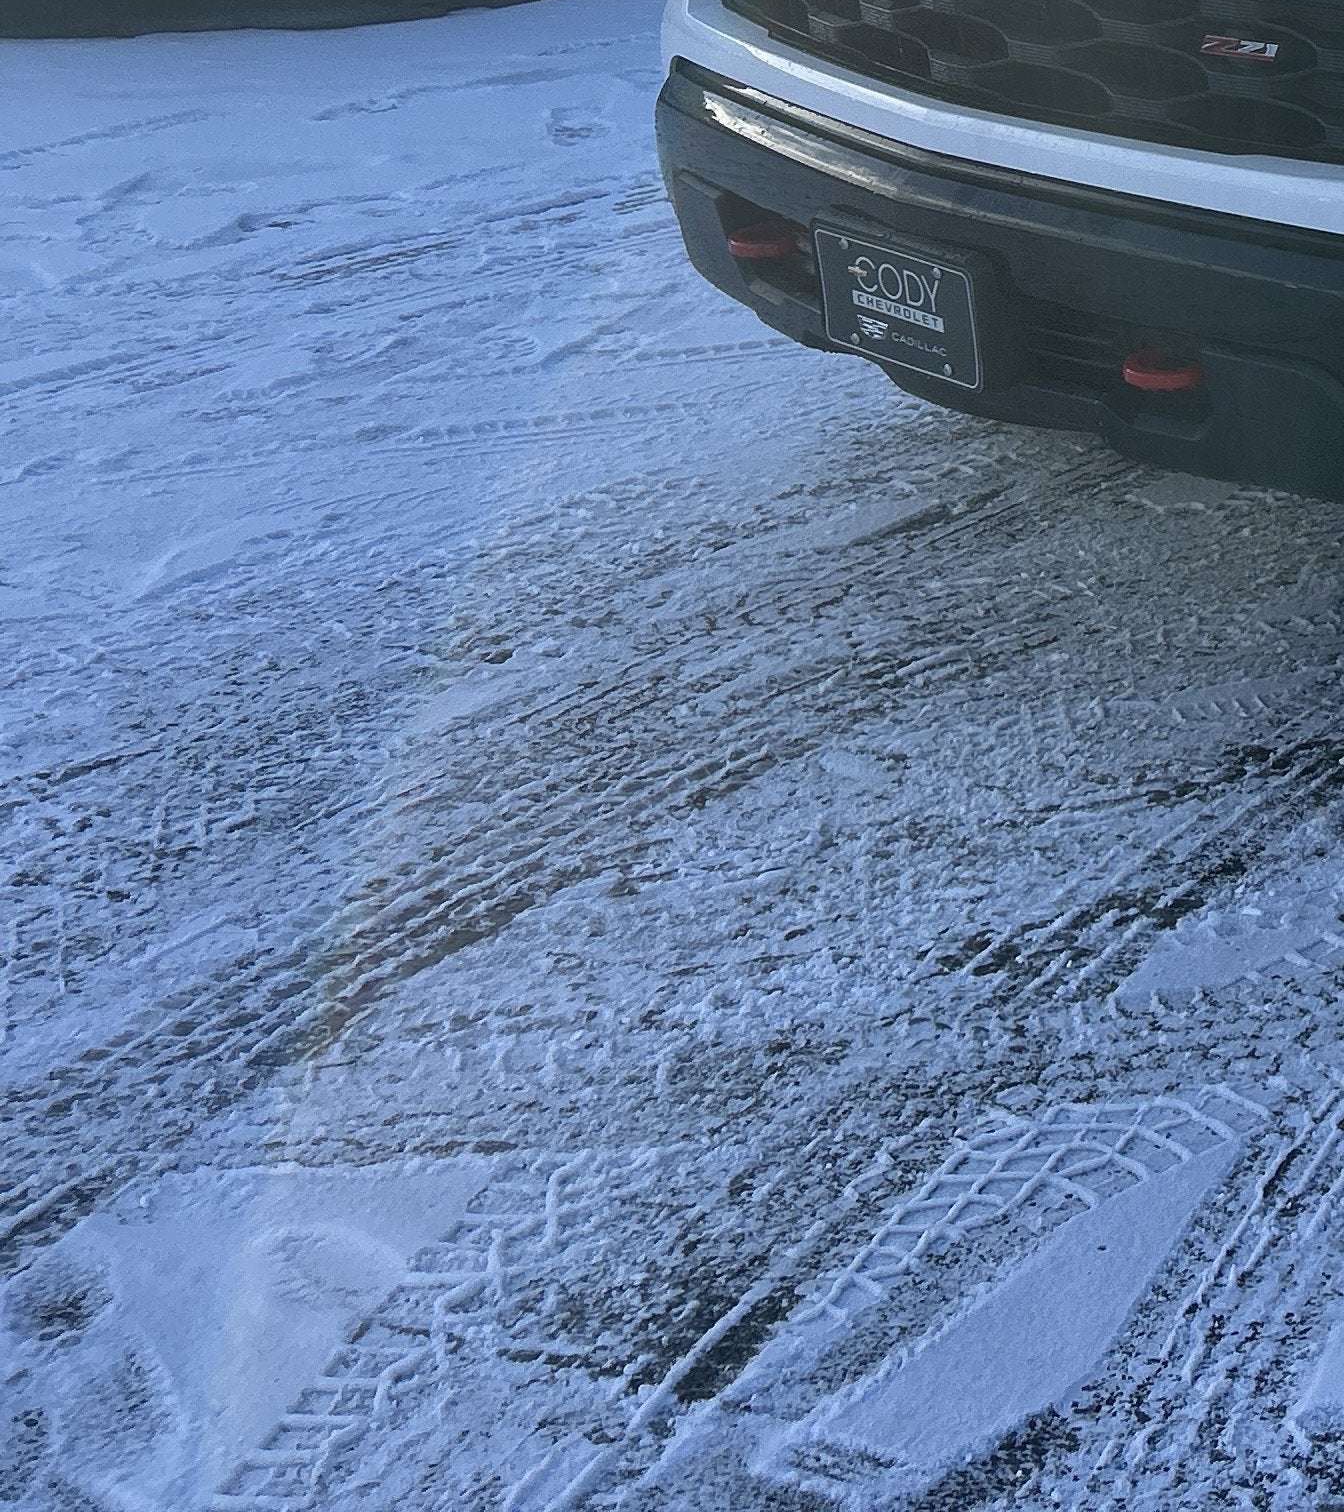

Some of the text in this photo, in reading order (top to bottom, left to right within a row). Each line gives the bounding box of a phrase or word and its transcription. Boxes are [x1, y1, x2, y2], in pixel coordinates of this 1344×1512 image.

[1199, 34, 1280, 62] Z71
[855, 256, 939, 313] CODY
[857, 293, 939, 329] CHEVROLET
[891, 331, 948, 357] CADILLAC
